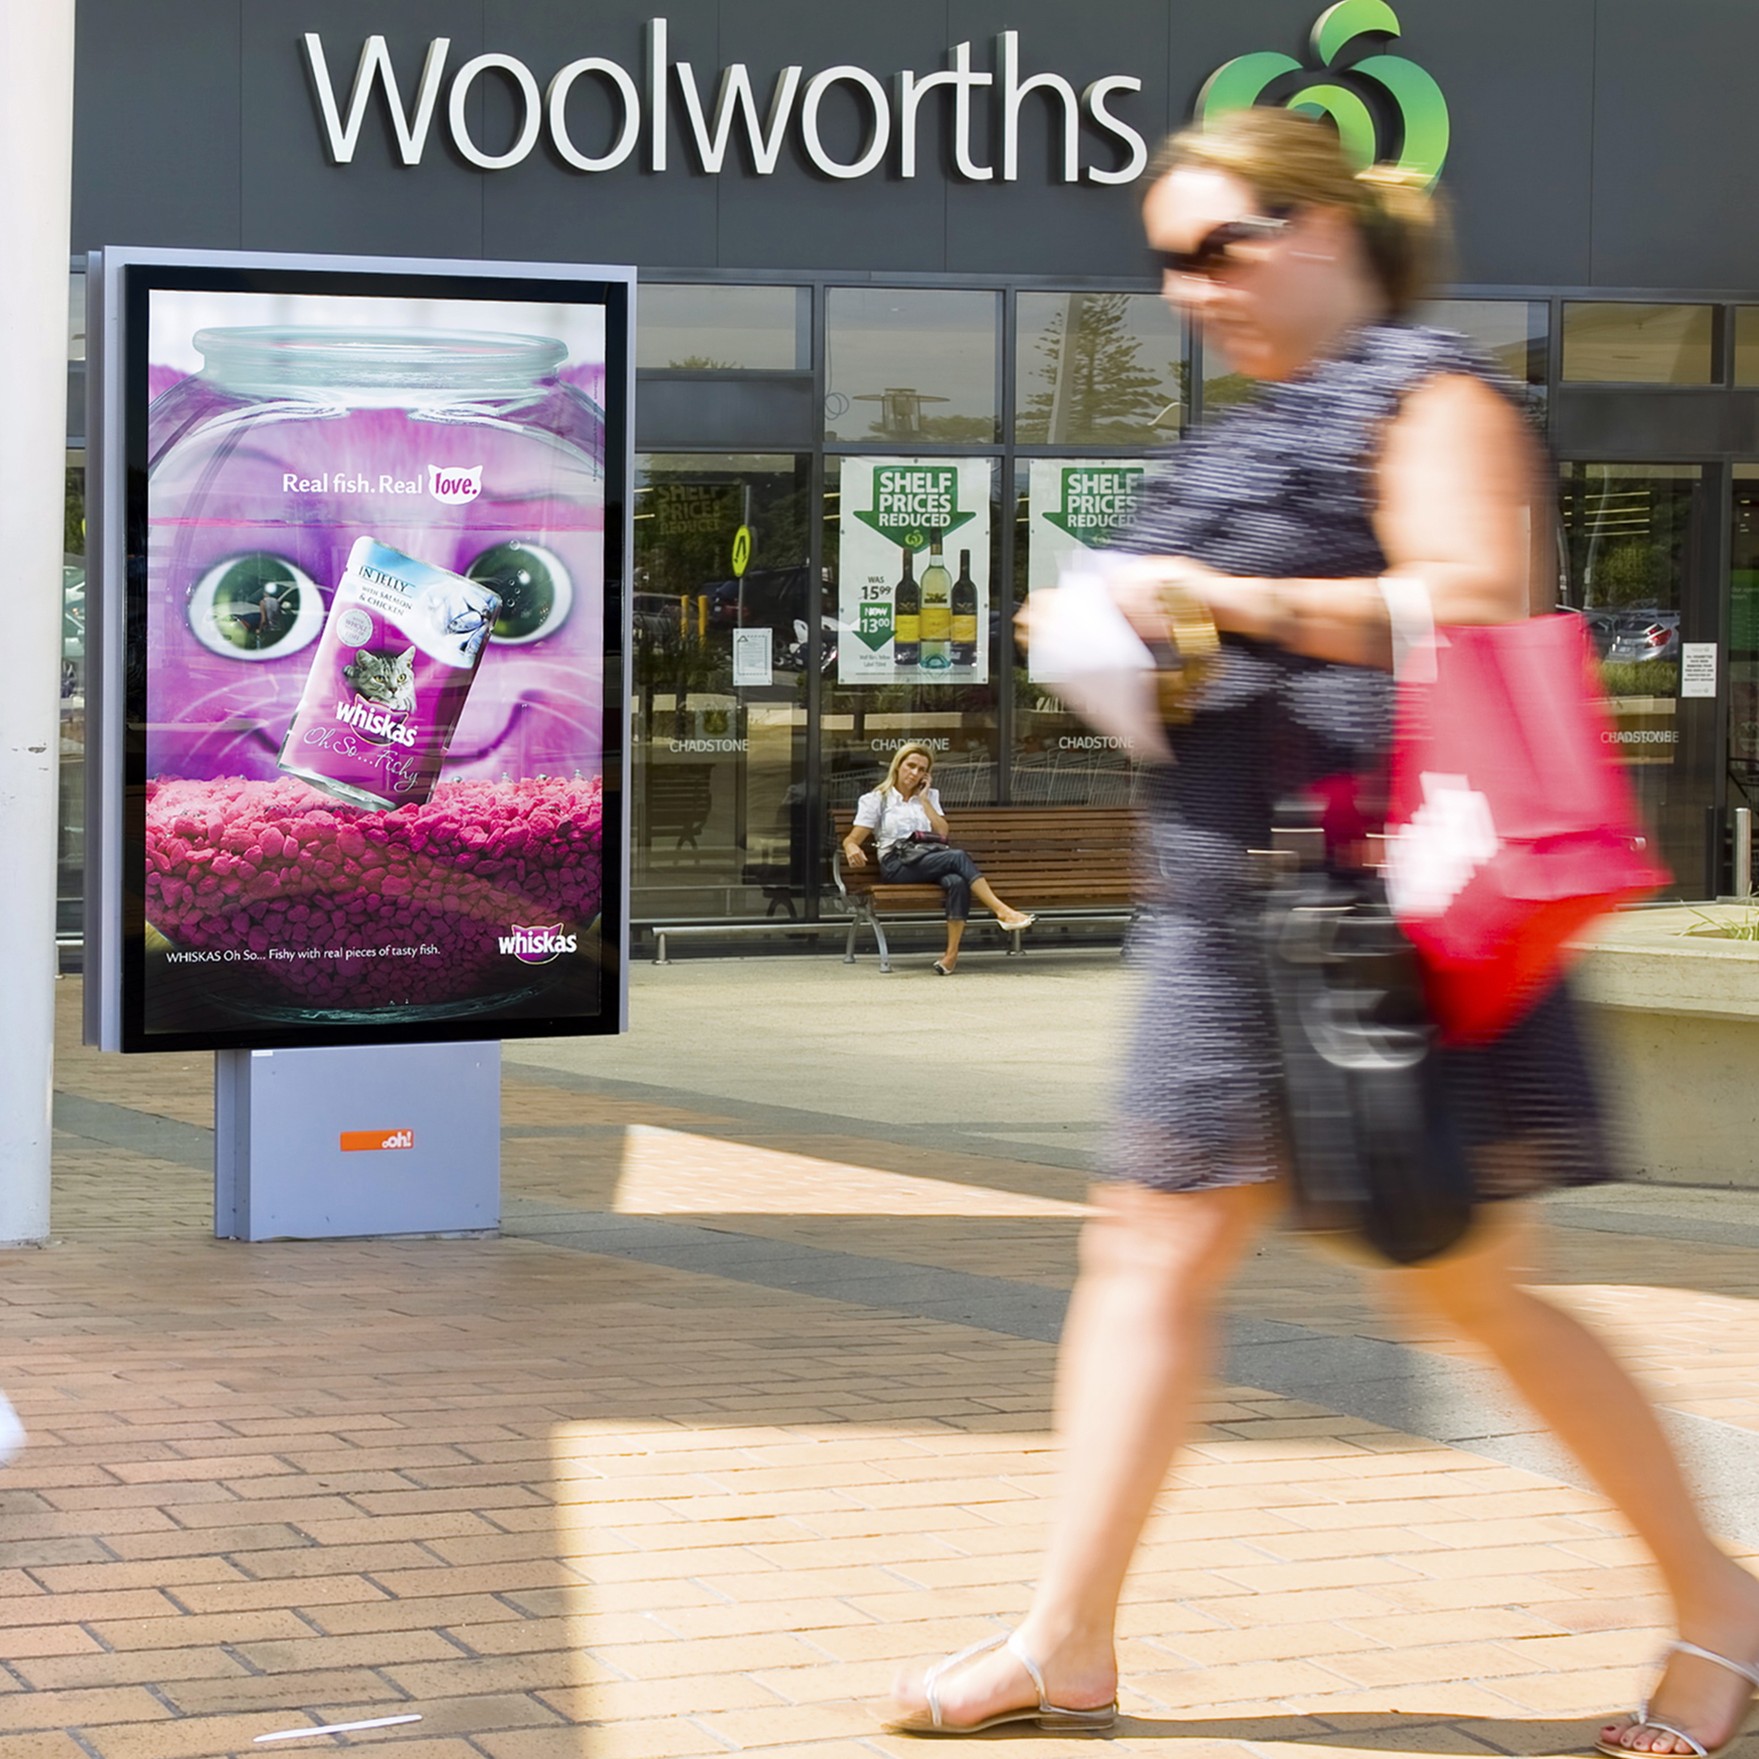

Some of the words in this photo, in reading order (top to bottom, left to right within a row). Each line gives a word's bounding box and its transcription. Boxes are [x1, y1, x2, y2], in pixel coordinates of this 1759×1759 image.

[303, 17, 1149, 186] Woolworths
[282, 472, 328, 493] Real
[333, 473, 376, 494] fish.
[379, 474, 423, 494] Real
[434, 472, 478, 495] love.
[879, 471, 953, 494] SHELF
[1067, 473, 1139, 495] SHELF
[879, 494, 952, 513] PRICES
[1067, 495, 1139, 514] PRICES
[878, 513, 952, 527] REDUCED
[358, 565, 374, 579] IN
[374, 571, 409, 592] JELLY
[867, 576, 885, 584] WAS
[367, 596, 405, 616] CHICKEN
[380, 591, 413, 610] SALMON
[864, 607, 889, 617] NOW
[335, 701, 418, 747] whiskas
[303, 726, 337, 749] Oh
[669, 738, 749, 752] CHADSTONE
[1058, 736, 1135, 749] CHADSTONE
[498, 930, 578, 955] whiskas
[166, 950, 221, 963] WHISKAS
[223, 949, 241, 962] Oh
[243, 949, 266, 961] So...
[269, 948, 295, 962] Fishy
[297, 947, 321, 959] with
[323, 947, 343, 959] real
[345, 946, 377, 961] pieces
[378, 944, 392, 957] of
[392, 945, 418, 959] tasty
[419, 943, 441, 956] fish.
